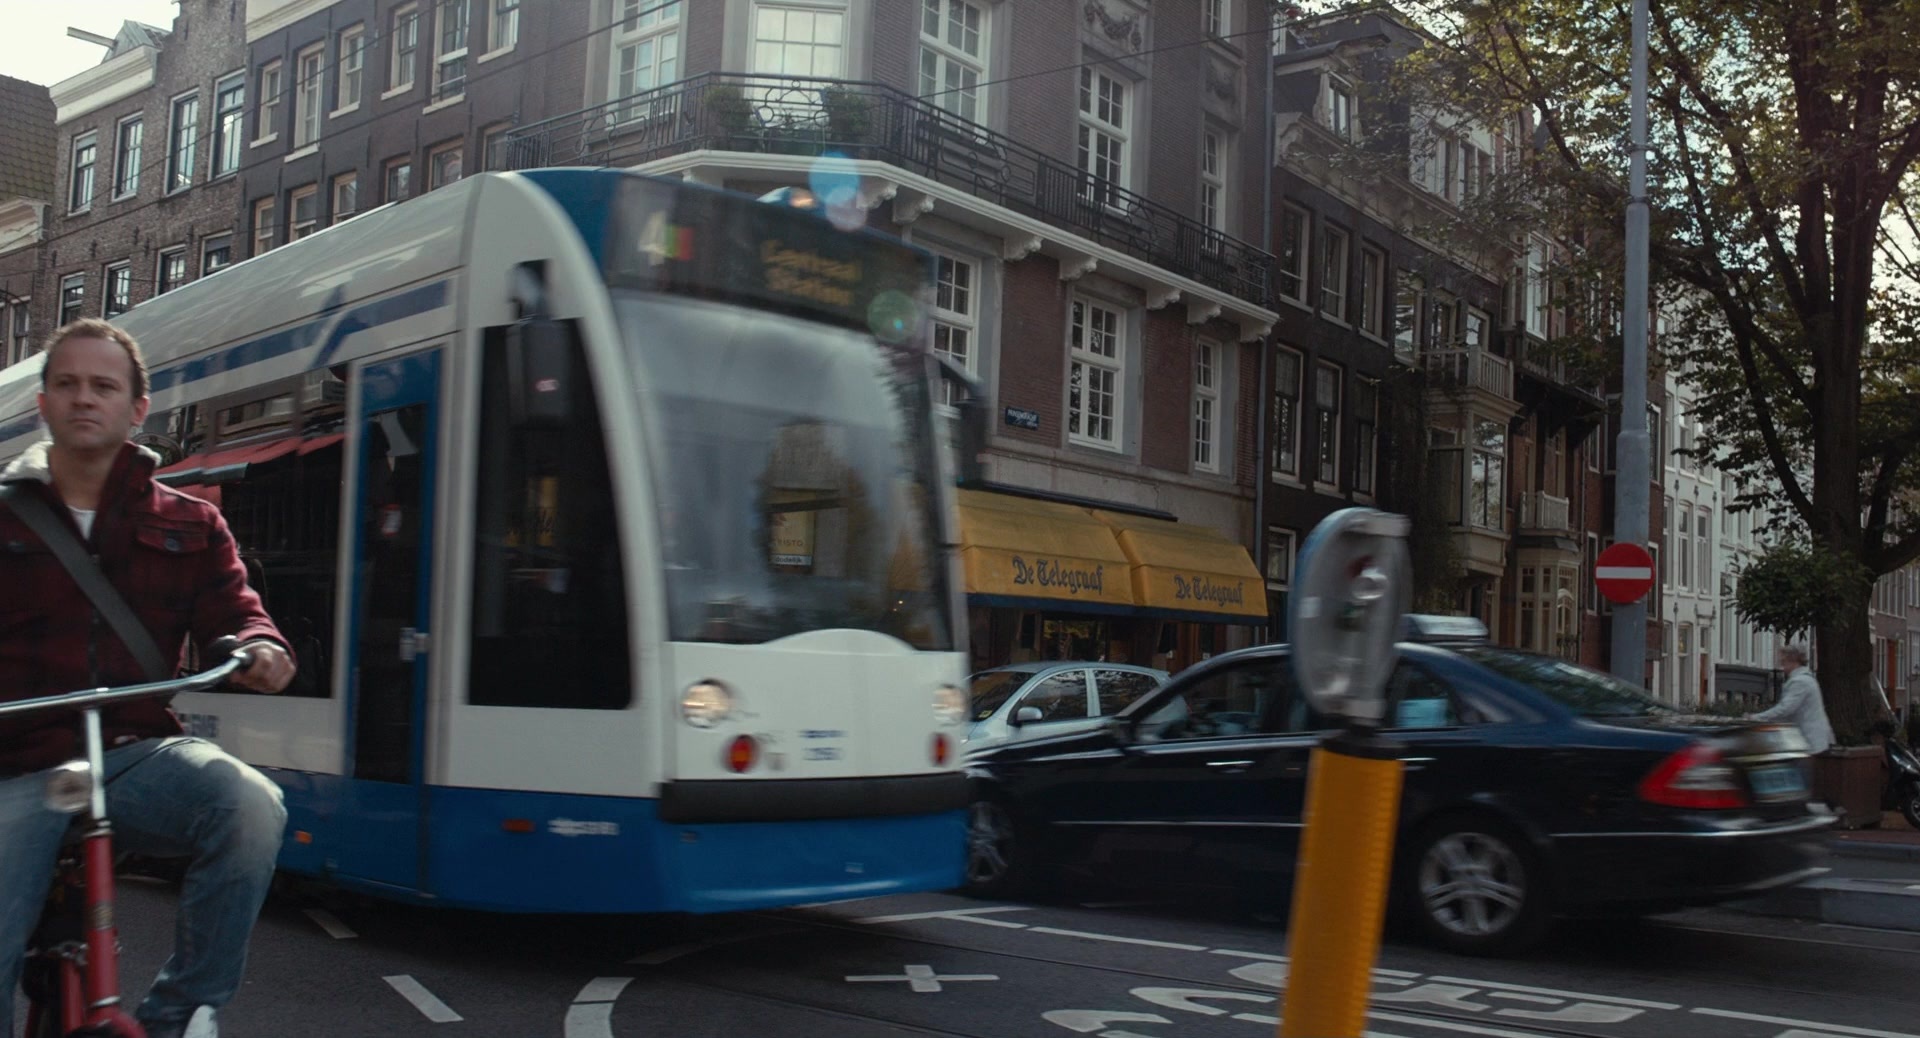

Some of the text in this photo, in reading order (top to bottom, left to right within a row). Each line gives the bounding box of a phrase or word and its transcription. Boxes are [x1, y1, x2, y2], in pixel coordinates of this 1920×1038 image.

[1012, 555, 1103, 596] De Telegraaf
[1174, 574, 1244, 608] De Telegraaf
